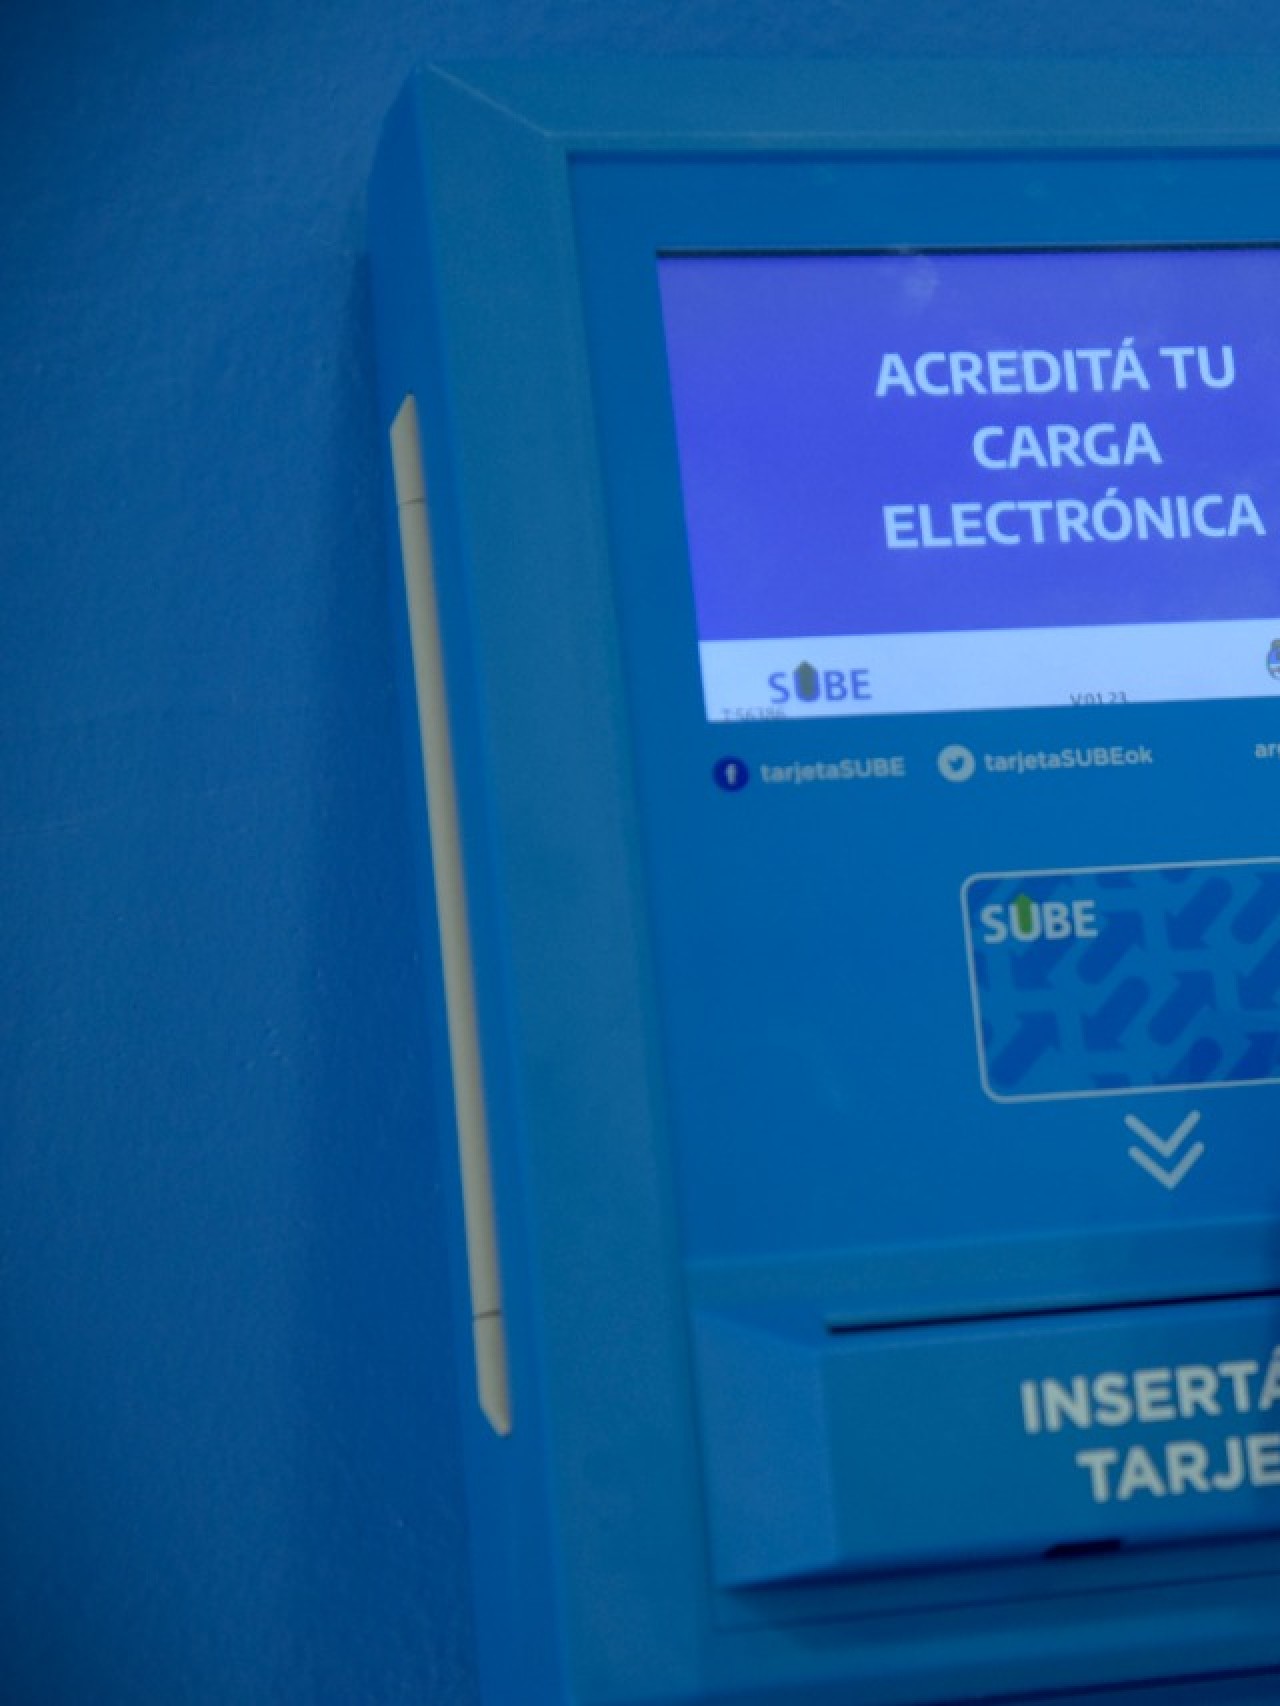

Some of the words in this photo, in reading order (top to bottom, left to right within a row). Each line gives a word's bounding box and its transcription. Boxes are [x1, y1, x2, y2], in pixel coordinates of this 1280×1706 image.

[875, 337, 1151, 397] ACREDITÁ
[1162, 345, 1236, 391] TU
[972, 421, 1163, 469] CARGA
[882, 487, 1266, 549] ELECTRÓNICA
[768, 663, 872, 704] SUBE
[760, 756, 906, 785] tarjetaSUBE
[984, 745, 1153, 774] tarjetaSUBEok
[979, 894, 1099, 944] SUBE
